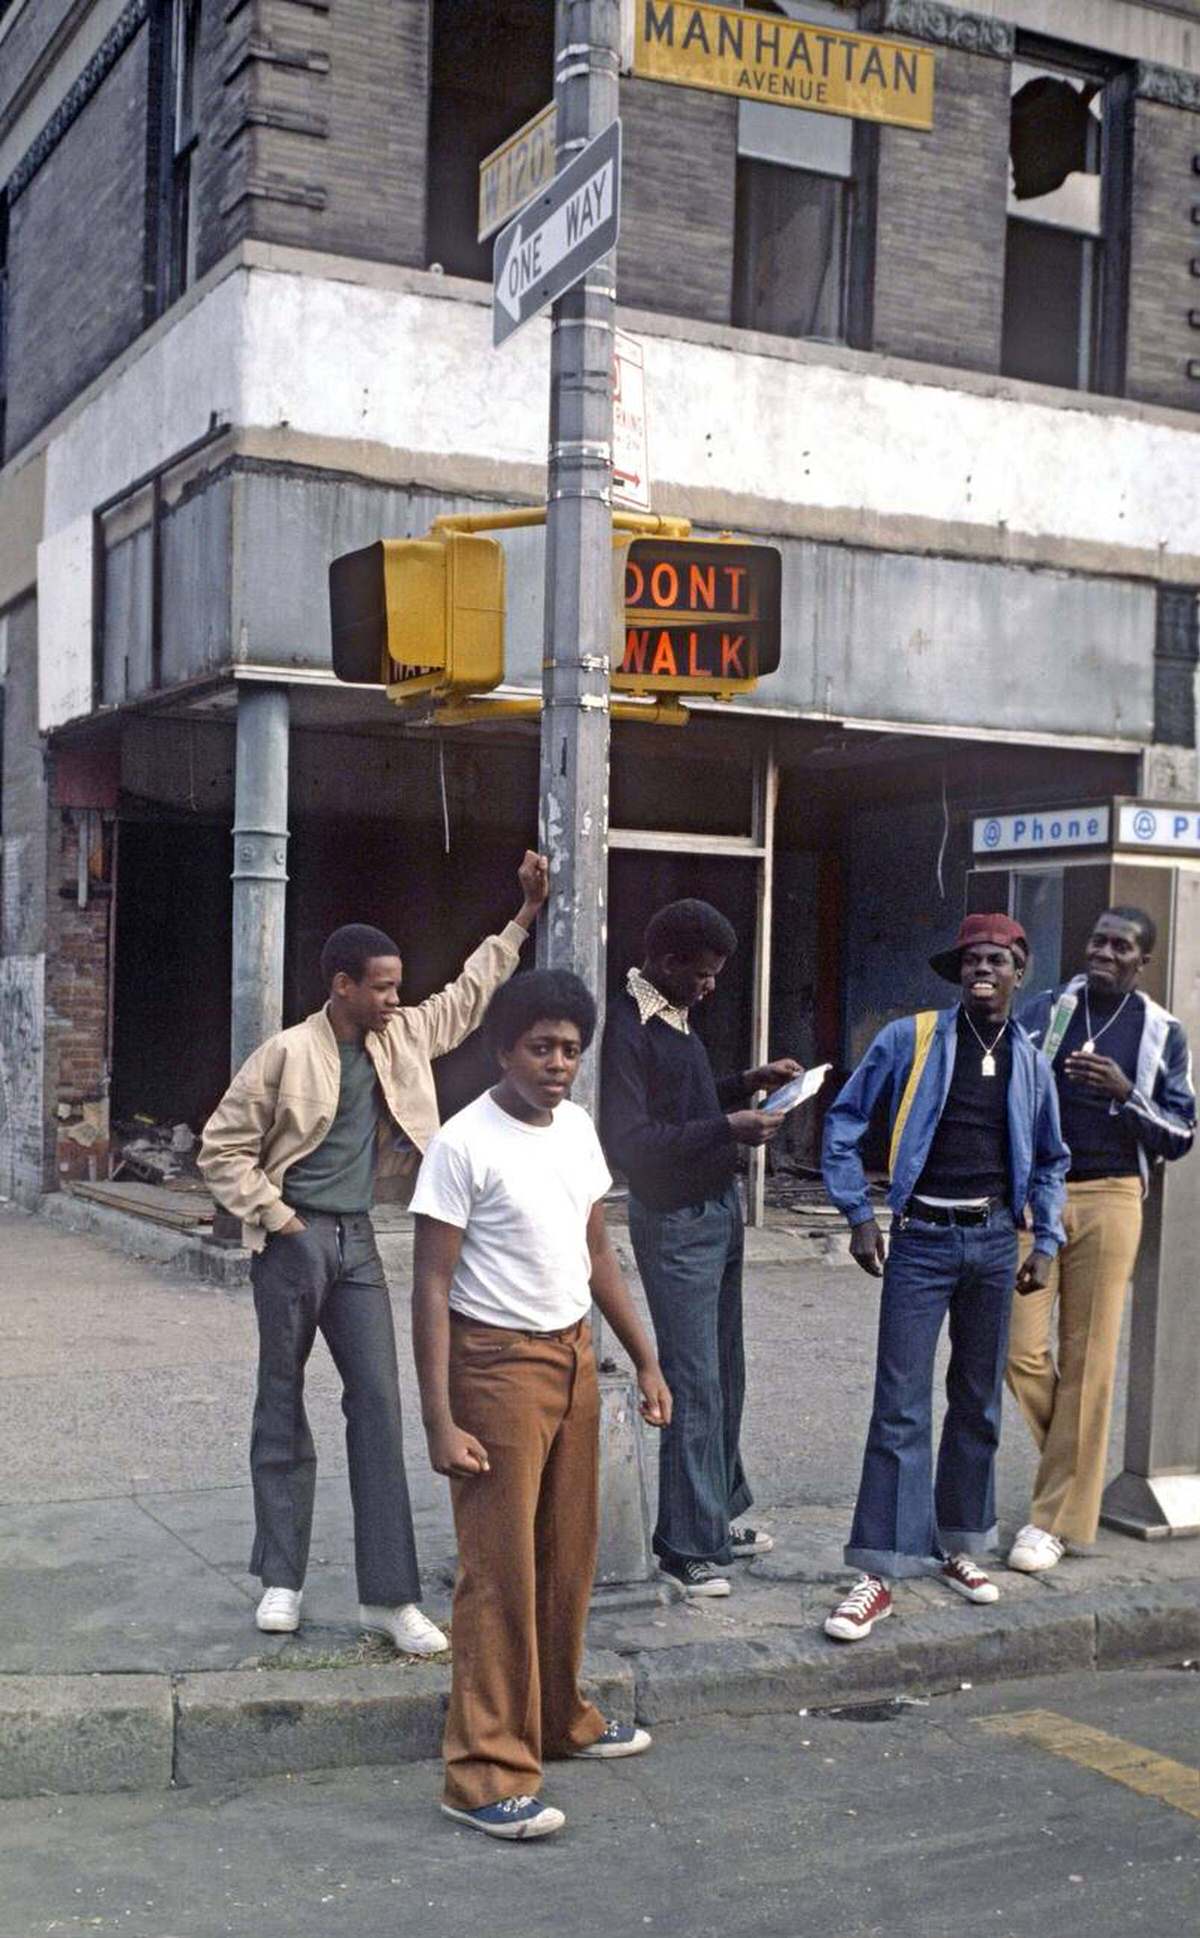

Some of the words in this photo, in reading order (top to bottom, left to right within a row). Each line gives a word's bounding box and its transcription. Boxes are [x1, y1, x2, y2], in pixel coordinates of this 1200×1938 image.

[644, 0, 918, 95] MANHATTAN
[737, 68, 828, 104] AVENUE
[485, 160, 501, 222] W
[508, 232, 543, 299] ONE
[566, 171, 607, 246] WAY
[624, 560, 748, 611] DONT
[622, 628, 748, 678] WALK
[1013, 817, 1100, 842] Phone
[1173, 815, 1200, 839] P
